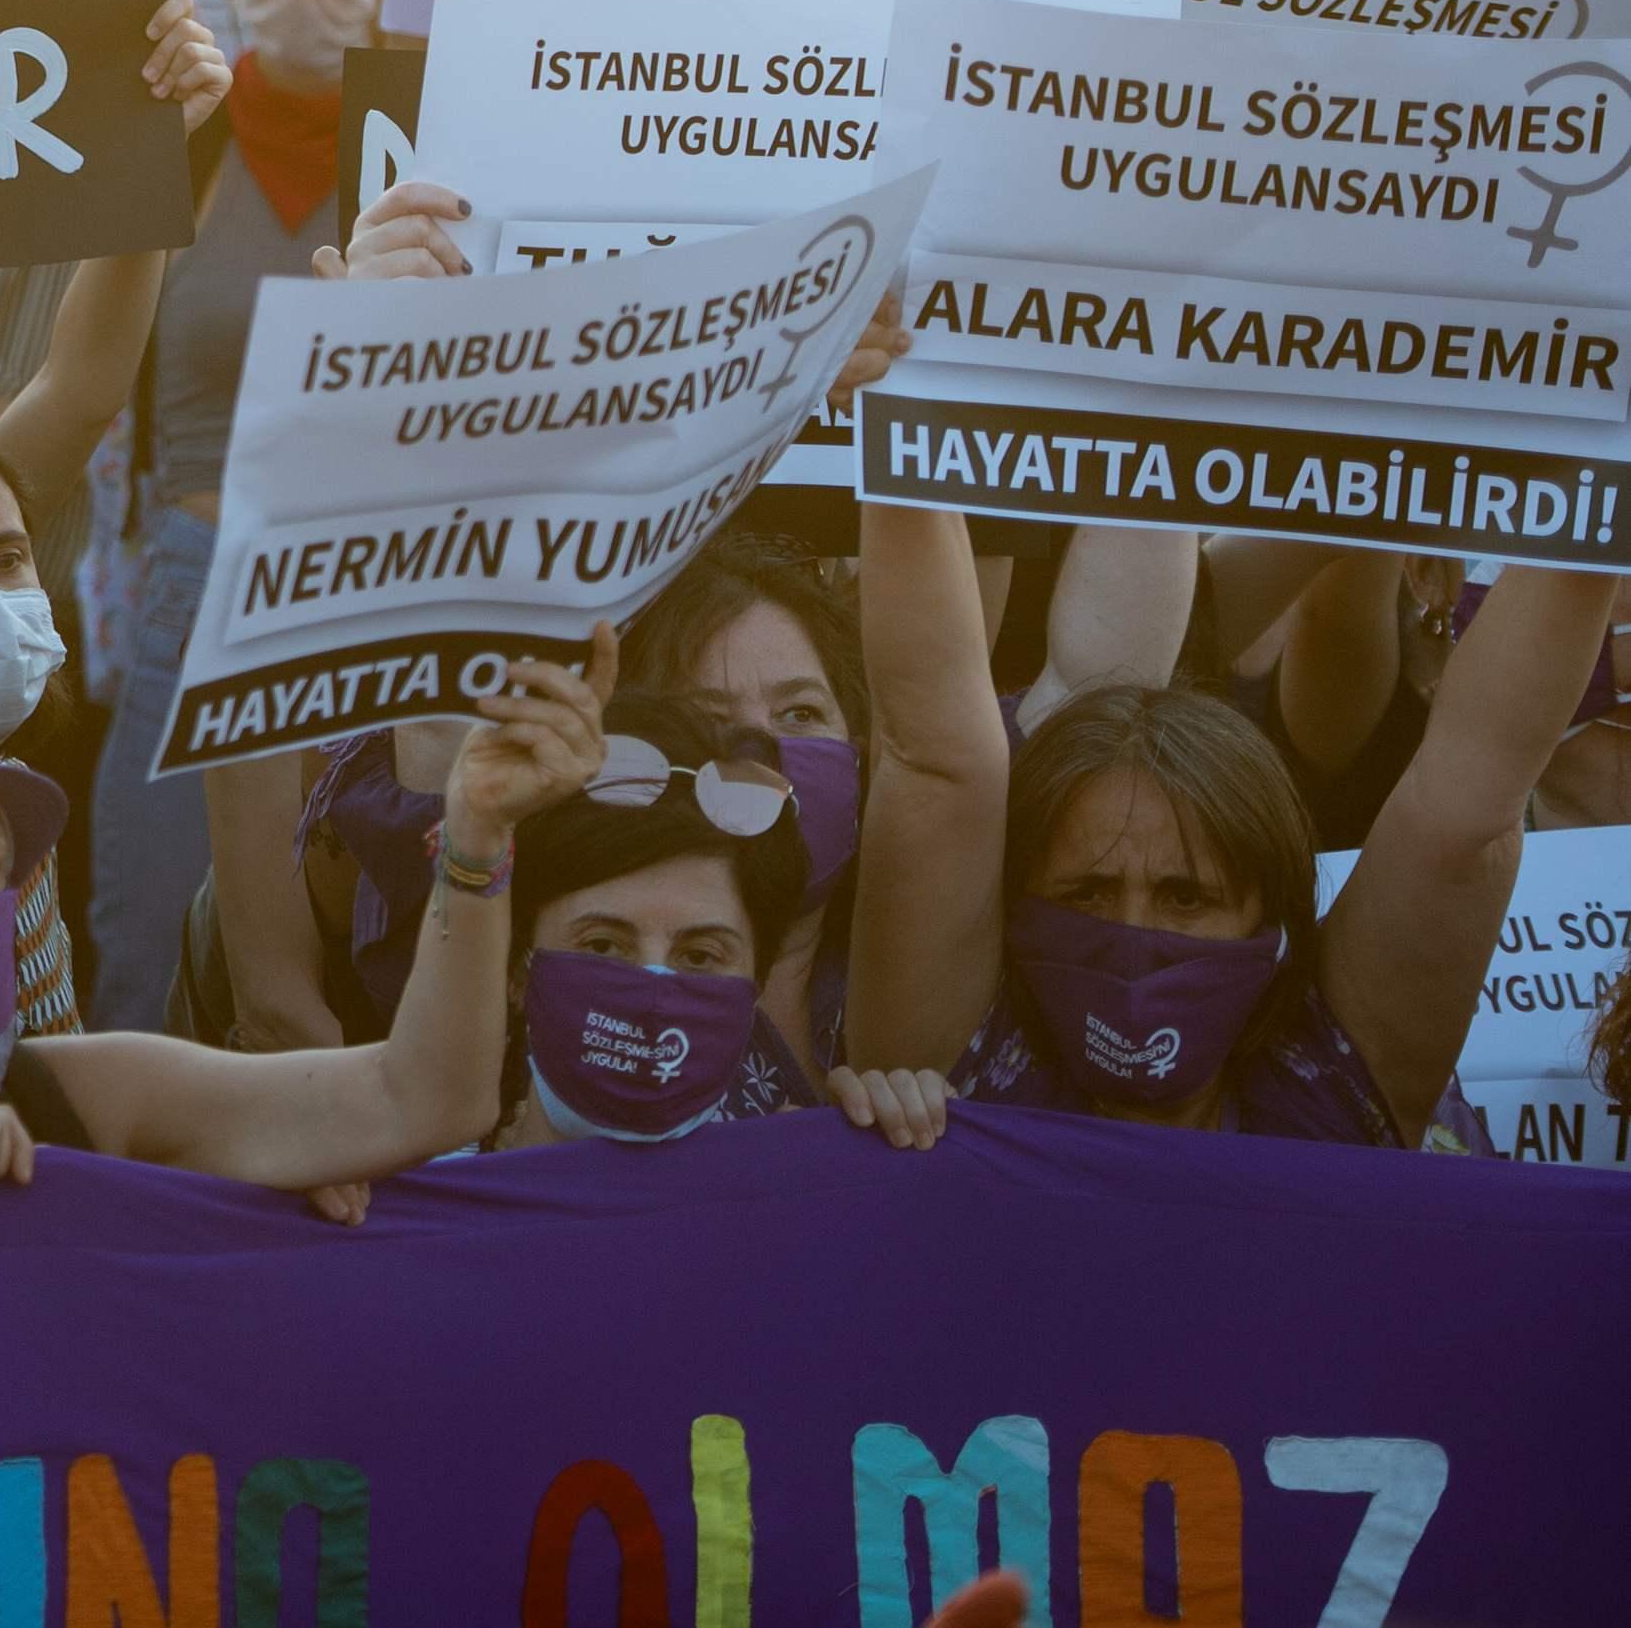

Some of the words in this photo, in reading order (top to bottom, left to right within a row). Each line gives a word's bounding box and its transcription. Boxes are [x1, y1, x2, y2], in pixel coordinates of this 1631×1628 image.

[530, 38, 751, 95] İSTANBUL
[761, 44, 888, 99] SÖZL
[942, 43, 1226, 134] İSTANBUL
[1242, 81, 1609, 164] SÖZLEŞMESİ
[1059, 144, 1501, 225] UYGULANSAYDI
[302, 327, 556, 393] İSTANBUL
[571, 239, 854, 366] SÖZLEŞMESİ
[913, 279, 1157, 357] ALARA
[1175, 302, 1621, 392] KARADEMİR
[395, 347, 765, 447] UYGULANSAYDI
[888, 420, 1178, 502] HAYATTA
[1194, 446, 1619, 546] OLABİLİRDİ!
[242, 506, 515, 617] NERMİN
[189, 654, 444, 750] HAYATTA
[586, 1008, 647, 1041] İSTANBUL
[1085, 1010, 1138, 1051] İSTANBUL
